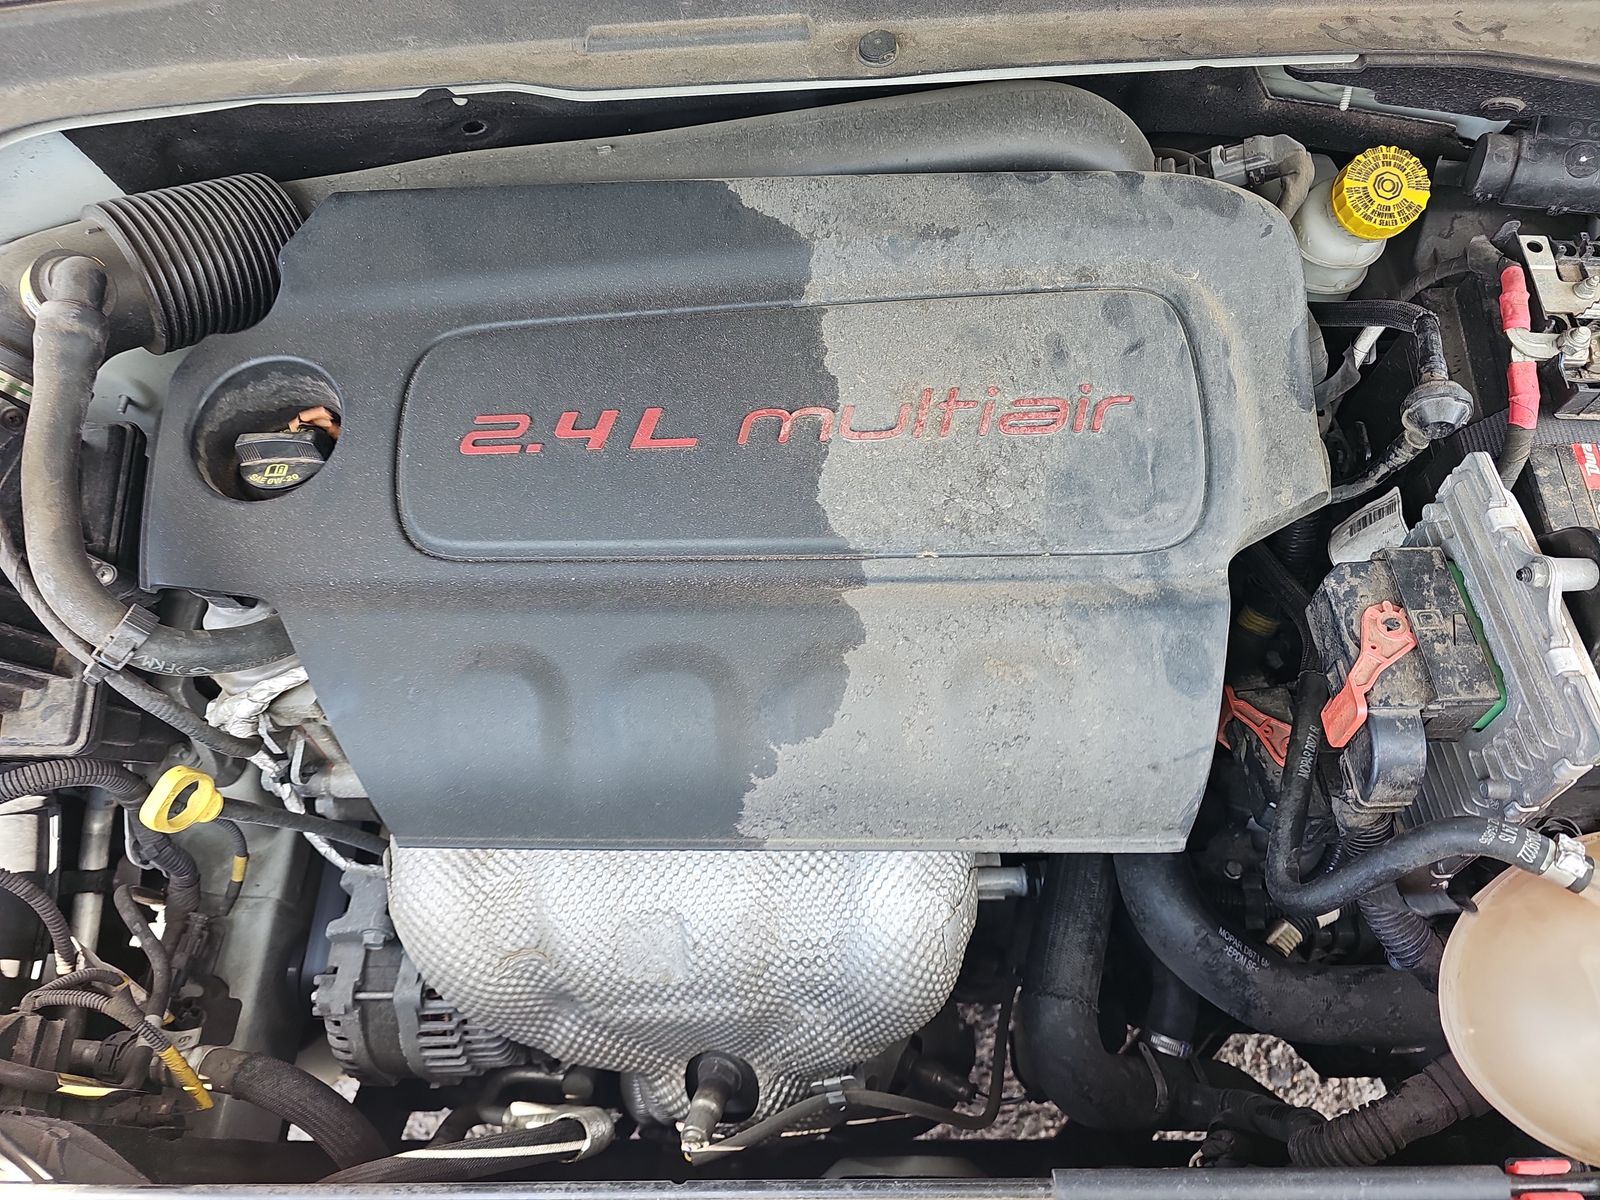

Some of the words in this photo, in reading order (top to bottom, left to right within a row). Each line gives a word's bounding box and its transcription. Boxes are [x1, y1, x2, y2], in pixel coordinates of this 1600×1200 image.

[1353, 186, 1362, 194] CAP
[1349, 199, 1361, 213] FLUID
[1359, 210, 1373, 222] FROM
[1378, 219, 1398, 227] SEALED
[1399, 204, 1423, 224] CONTAINER
[1355, 195, 1371, 212] BEFORE
[1393, 197, 1409, 211] FILLER
[737, 384, 1133, 444] multiair
[249, 473, 268, 484] SAE
[266, 473, 300, 485] 0W-20
[1297, 750, 1314, 780] MOPAR
[1219, 926, 1243, 951] MOPAR
